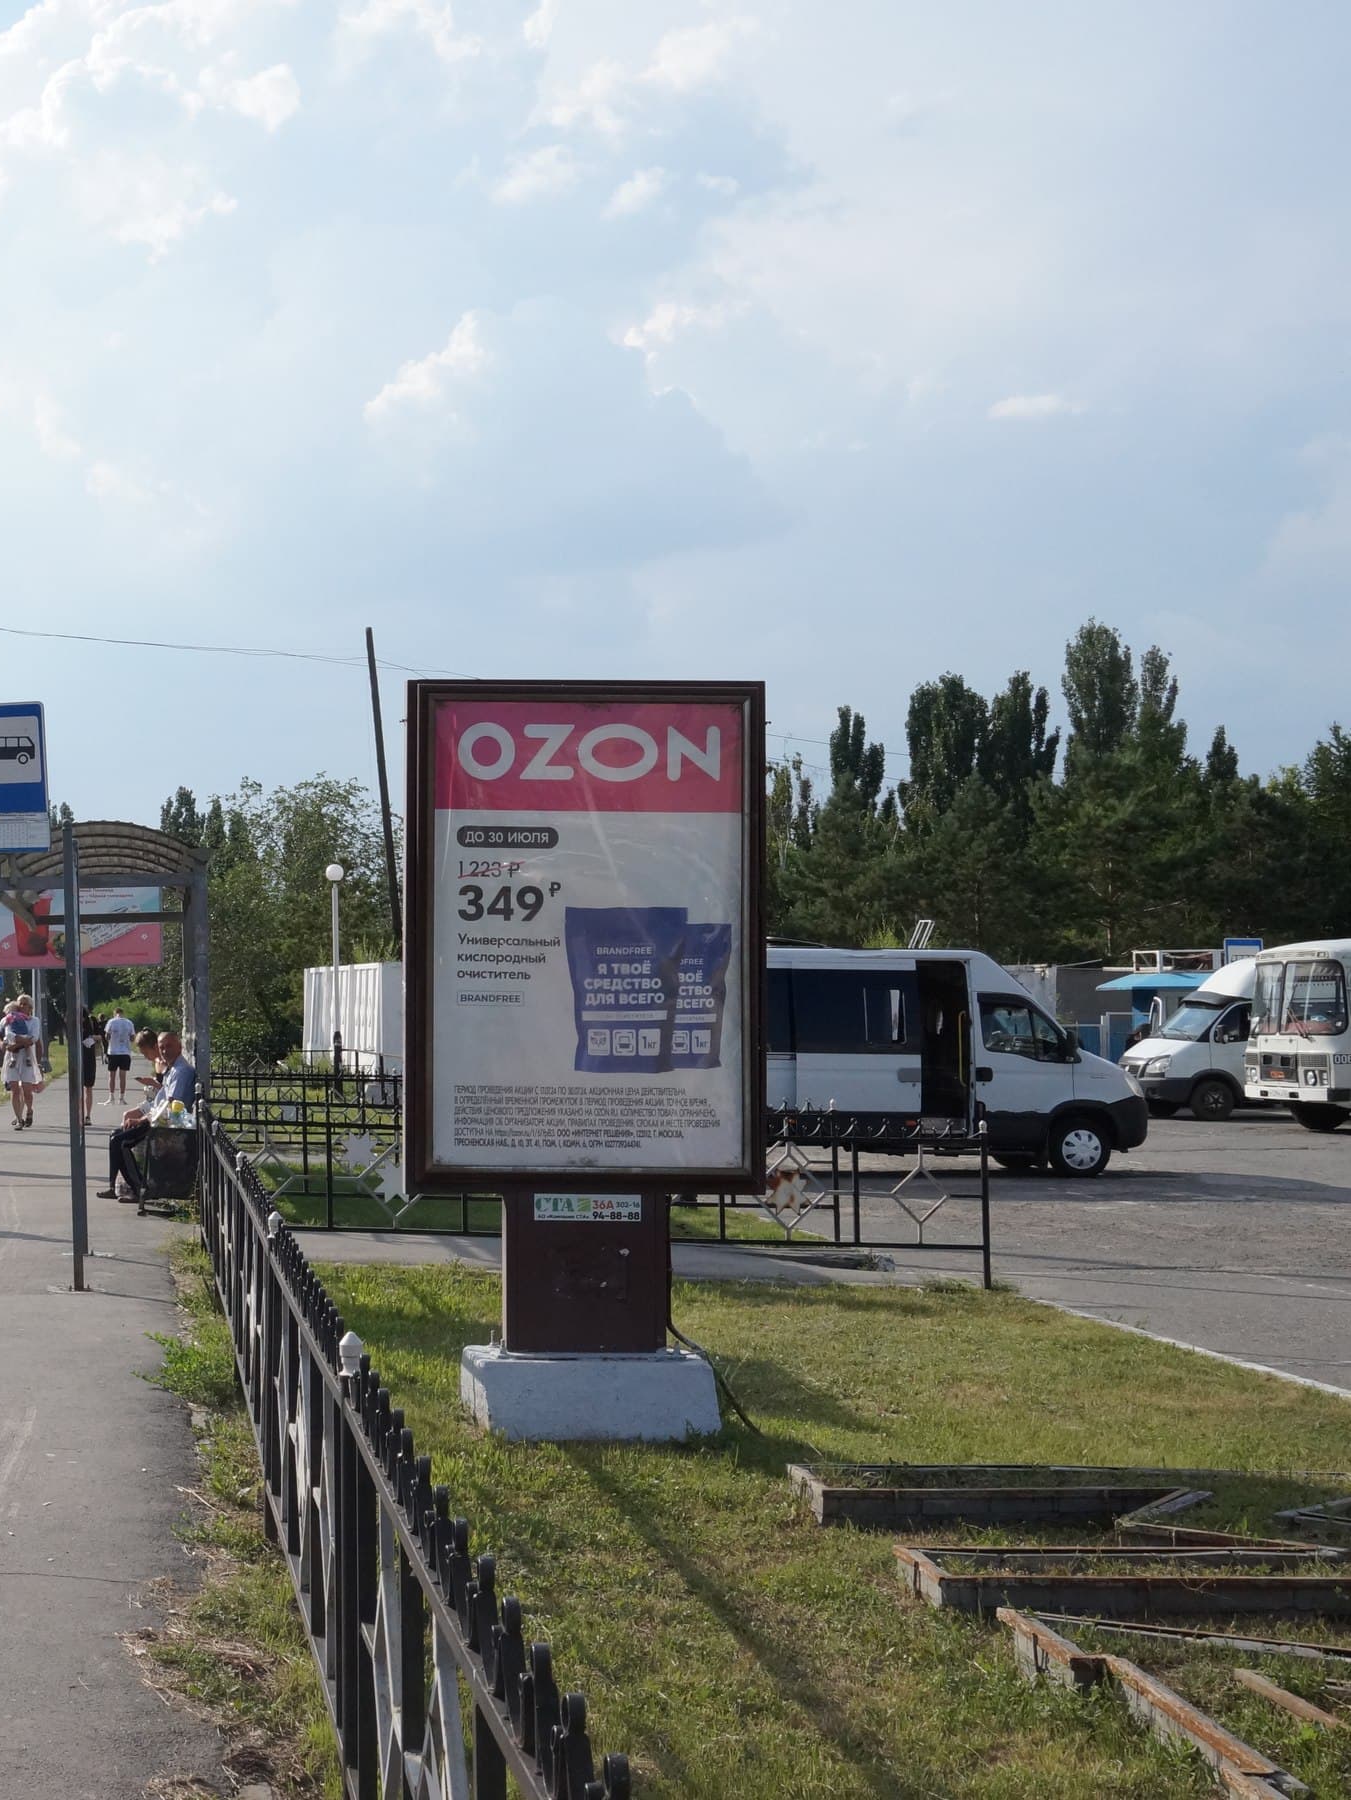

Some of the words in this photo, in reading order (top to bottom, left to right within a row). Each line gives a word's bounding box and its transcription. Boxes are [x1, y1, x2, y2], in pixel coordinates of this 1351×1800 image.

[458, 722, 721, 782] OZON
[465, 831, 484, 844] ДО
[488, 831, 504, 843] 30
[507, 831, 550, 844] ИЮЛЯ
[457, 933, 561, 948] Универсальный
[596, 946, 653, 955] BRANDFREE
[457, 952, 546, 966] кислородный
[598, 963, 608, 976] Я
[611, 959, 652, 976] ТВОЁ
[457, 969, 531, 981] очиститель
[584, 978, 662, 991] СРЕДСТВО
[460, 993, 521, 1004] BRANDFREE
[585, 993, 615, 1007] ДЛЯ
[619, 992, 665, 1005] ВСЕГО
[535, 1197, 575, 1212] СТА
[592, 1211, 640, 1221] 94-88-88
